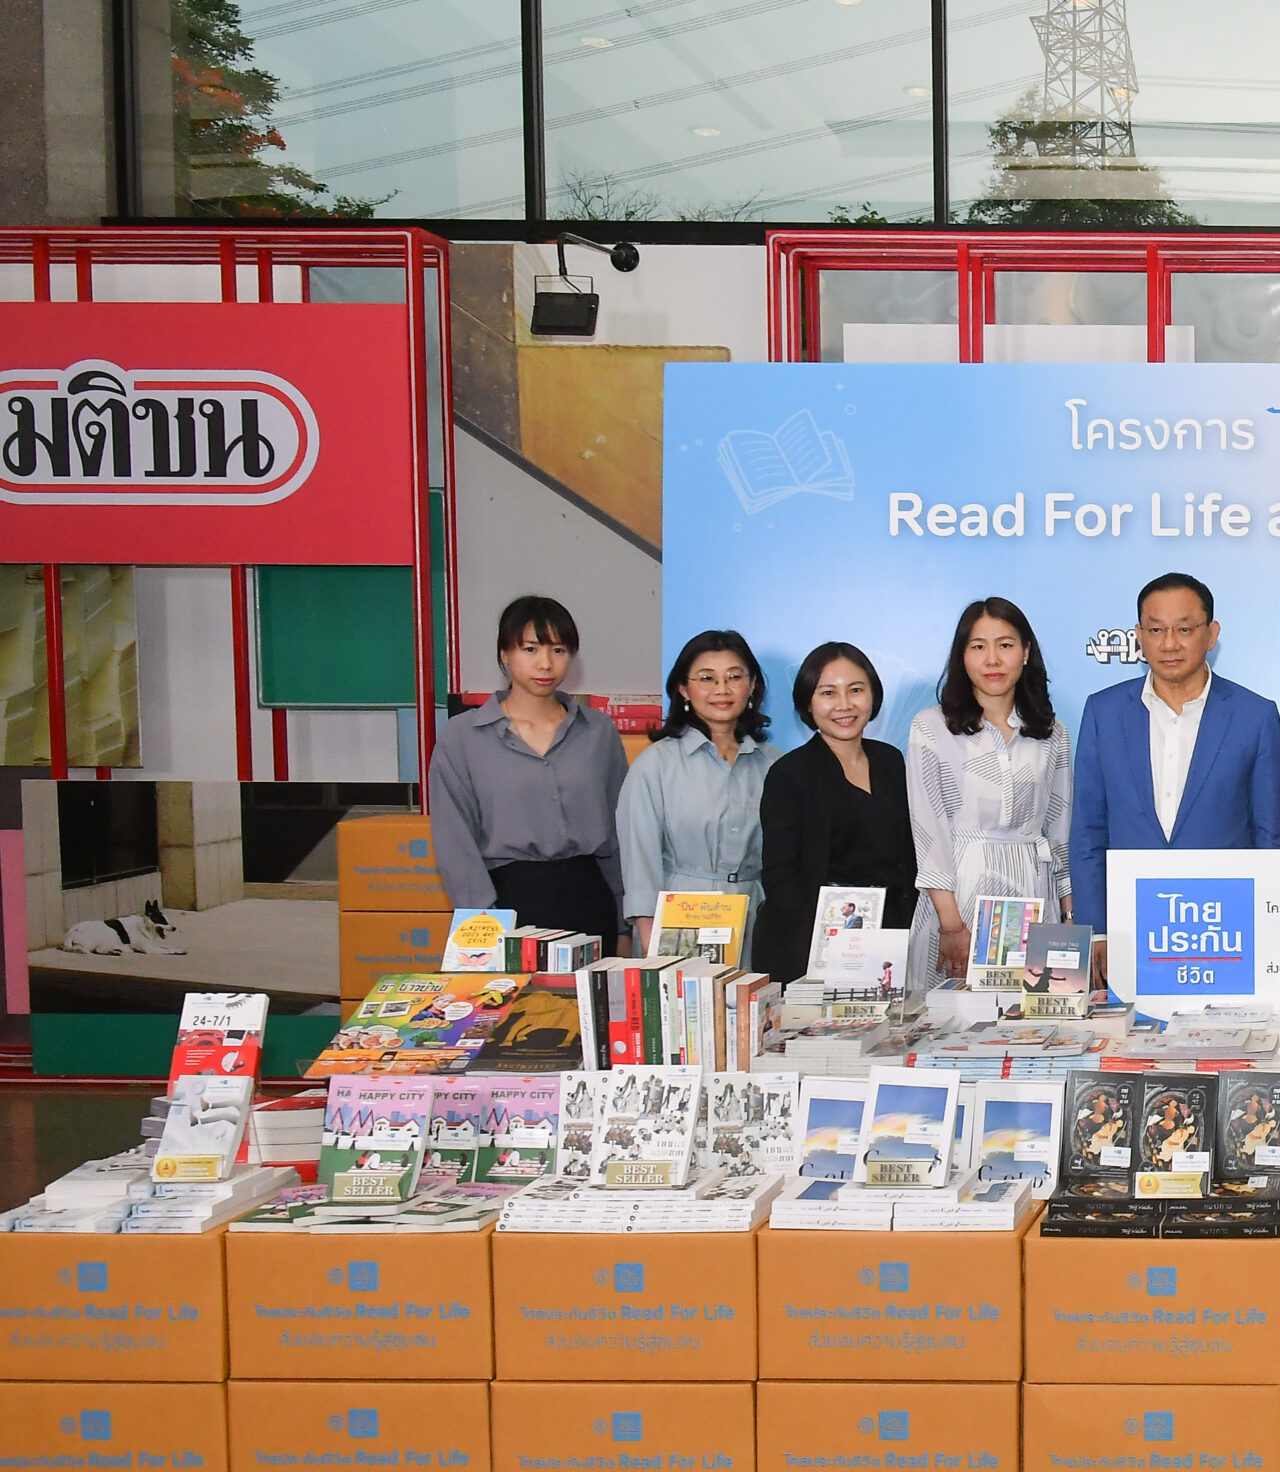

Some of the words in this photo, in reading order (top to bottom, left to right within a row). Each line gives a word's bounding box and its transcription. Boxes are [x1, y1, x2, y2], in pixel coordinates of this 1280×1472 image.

[3, 371, 275, 477] มติชน
[1064, 398, 1255, 451] โครงการ
[888, 491, 1025, 537] Read
[1045, 492, 1134, 537] For
[1151, 491, 1252, 537] Life
[1156, 892, 1223, 924] ไทย
[1148, 924, 1243, 953] ประกัน
[985, 970, 1014, 979] BEST
[1176, 966, 1215, 985] ชีวิต
[979, 979, 1020, 987] SELLER
[1038, 997, 1069, 1006] BEST
[1030, 1006, 1075, 1015] SELLER
[192, 1015, 232, 1026] 24-7/1
[358, 1092, 396, 1101] HAPPY
[399, 1092, 425, 1101] CITY
[452, 1092, 477, 1101] CITY
[491, 1090, 527, 1099] HAPPY
[530, 1091, 555, 1099] CITY
[623, 1164, 657, 1174] BEST
[880, 1163, 914, 1174] BEST
[352, 1176, 387, 1187] BEST
[615, 1174, 665, 1184] SELLER
[871, 1173, 921, 1184] SELLER
[343, 1186, 394, 1196] SELLER
[84, 1305, 130, 1321] Read
[135, 1305, 164, 1321] For
[168, 1304, 201, 1322] Life
[355, 1303, 401, 1320] Read
[406, 1303, 435, 1320] For
[439, 1302, 472, 1320] Life
[621, 1304, 666, 1321] Read
[671, 1304, 700, 1321] For
[704, 1304, 737, 1321] Life
[886, 1303, 931, 1321] Read
[936, 1304, 965, 1321] For
[969, 1303, 1001, 1321] Life
[1153, 1308, 1198, 1325] Read
[1203, 1308, 1232, 1325] For
[1236, 1308, 1269, 1326] Life
[355, 1449, 401, 1467] Read
[405, 1450, 435, 1467] For
[439, 1449, 471, 1467] Life
[885, 1452, 930, 1469] Read
[935, 1452, 964, 1469] For
[969, 1452, 1001, 1470] Life
